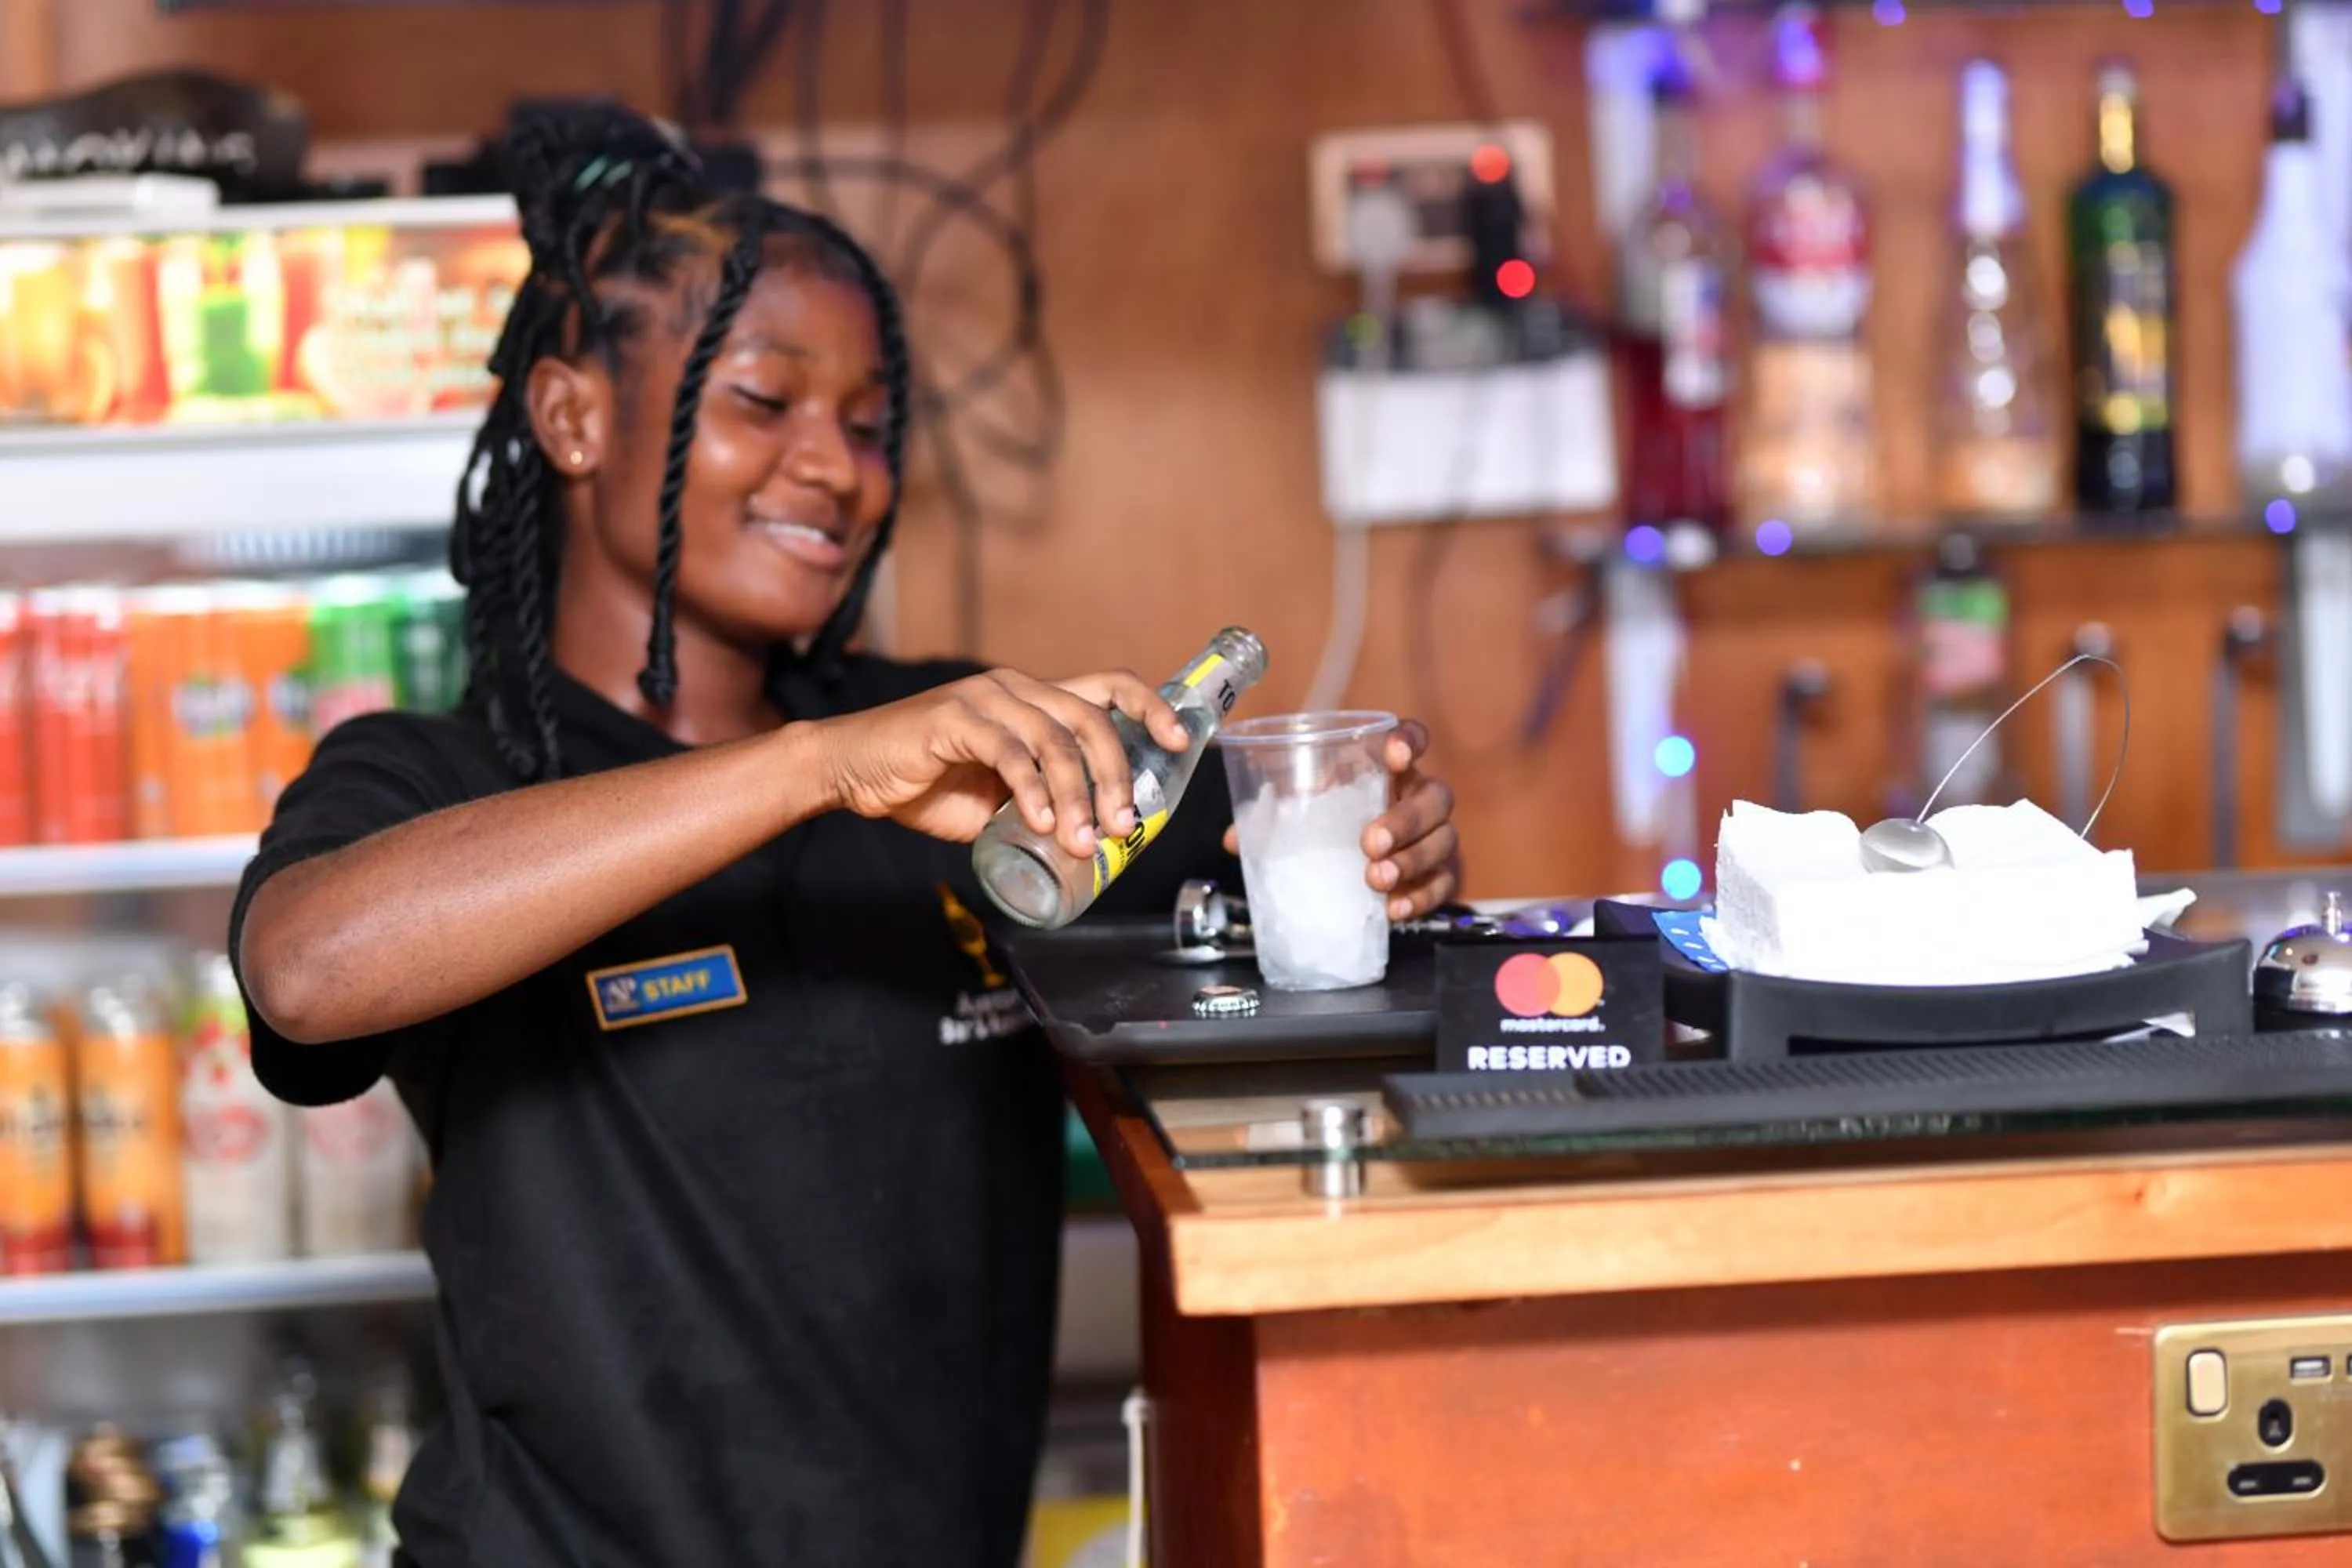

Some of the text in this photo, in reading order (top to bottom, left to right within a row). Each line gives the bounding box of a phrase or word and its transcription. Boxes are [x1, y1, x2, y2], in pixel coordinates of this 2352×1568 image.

[641, 969, 711, 1004] STAFF
[1499, 1015, 1600, 1033] mastercard
[1467, 1044, 1632, 1071] RESERVED
